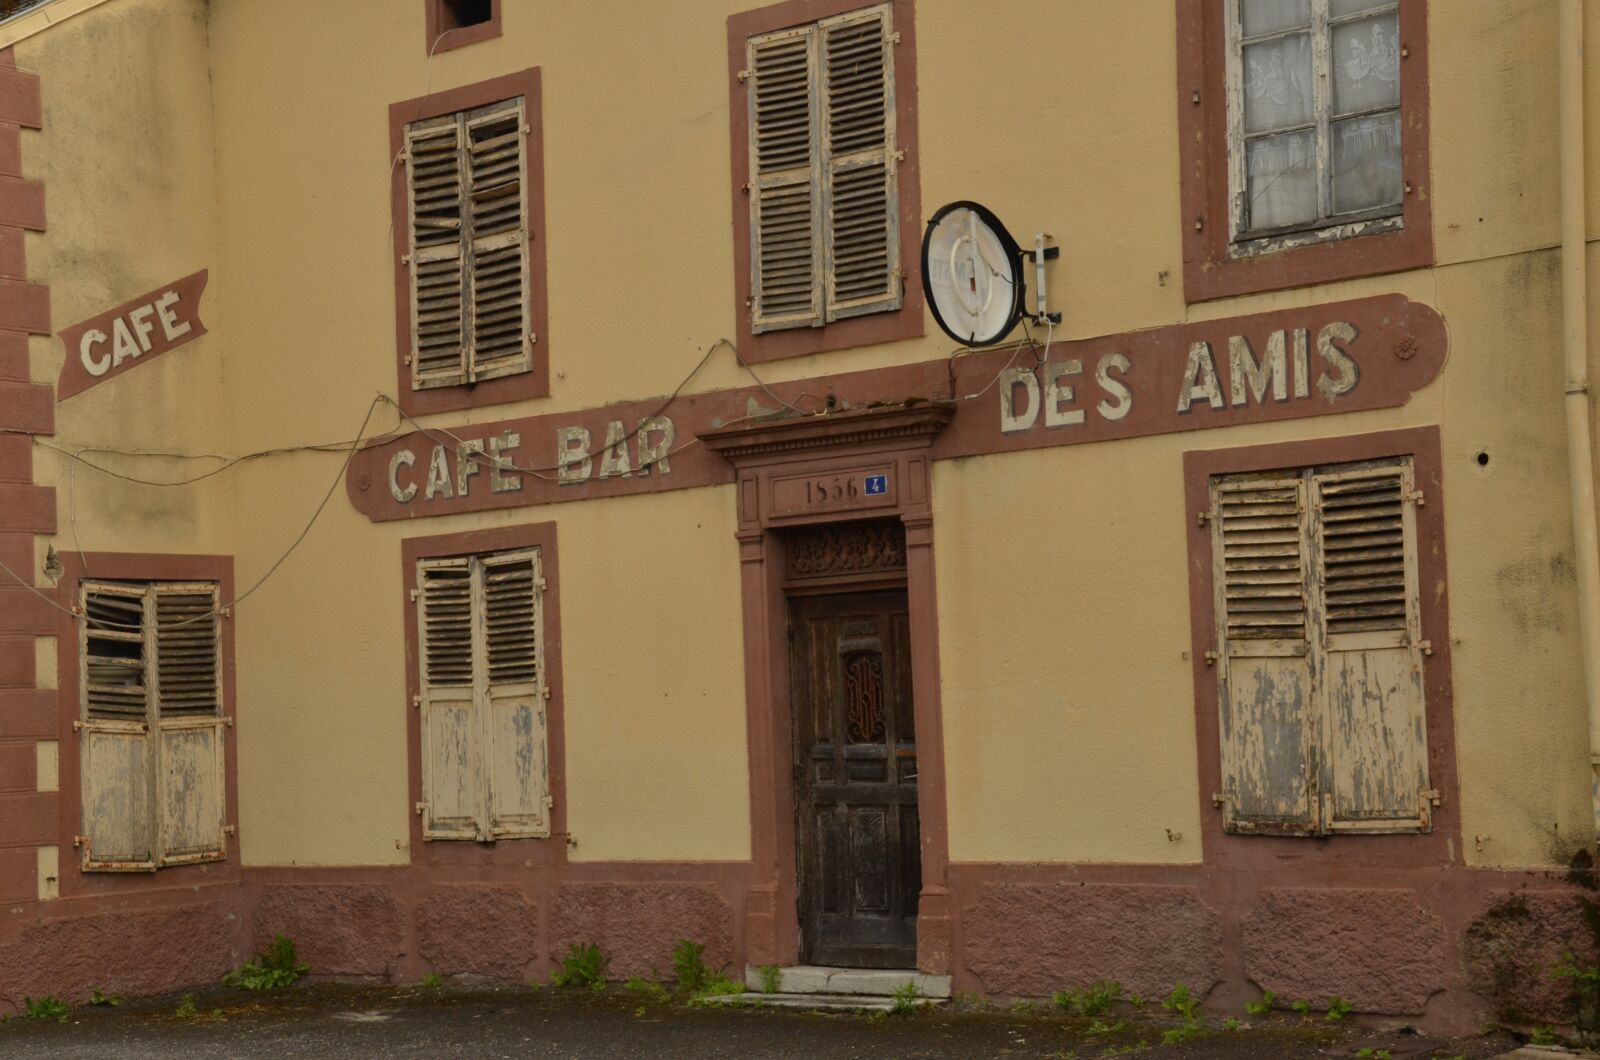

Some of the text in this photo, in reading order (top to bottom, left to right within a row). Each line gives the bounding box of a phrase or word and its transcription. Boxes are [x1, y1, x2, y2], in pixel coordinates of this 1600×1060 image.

[557, 415, 676, 485] BAR
[1000, 352, 1132, 434] DES
[1176, 321, 1361, 414] AMIS
[805, 477, 858, 504] 1856
[871, 478, 880, 492] 4
